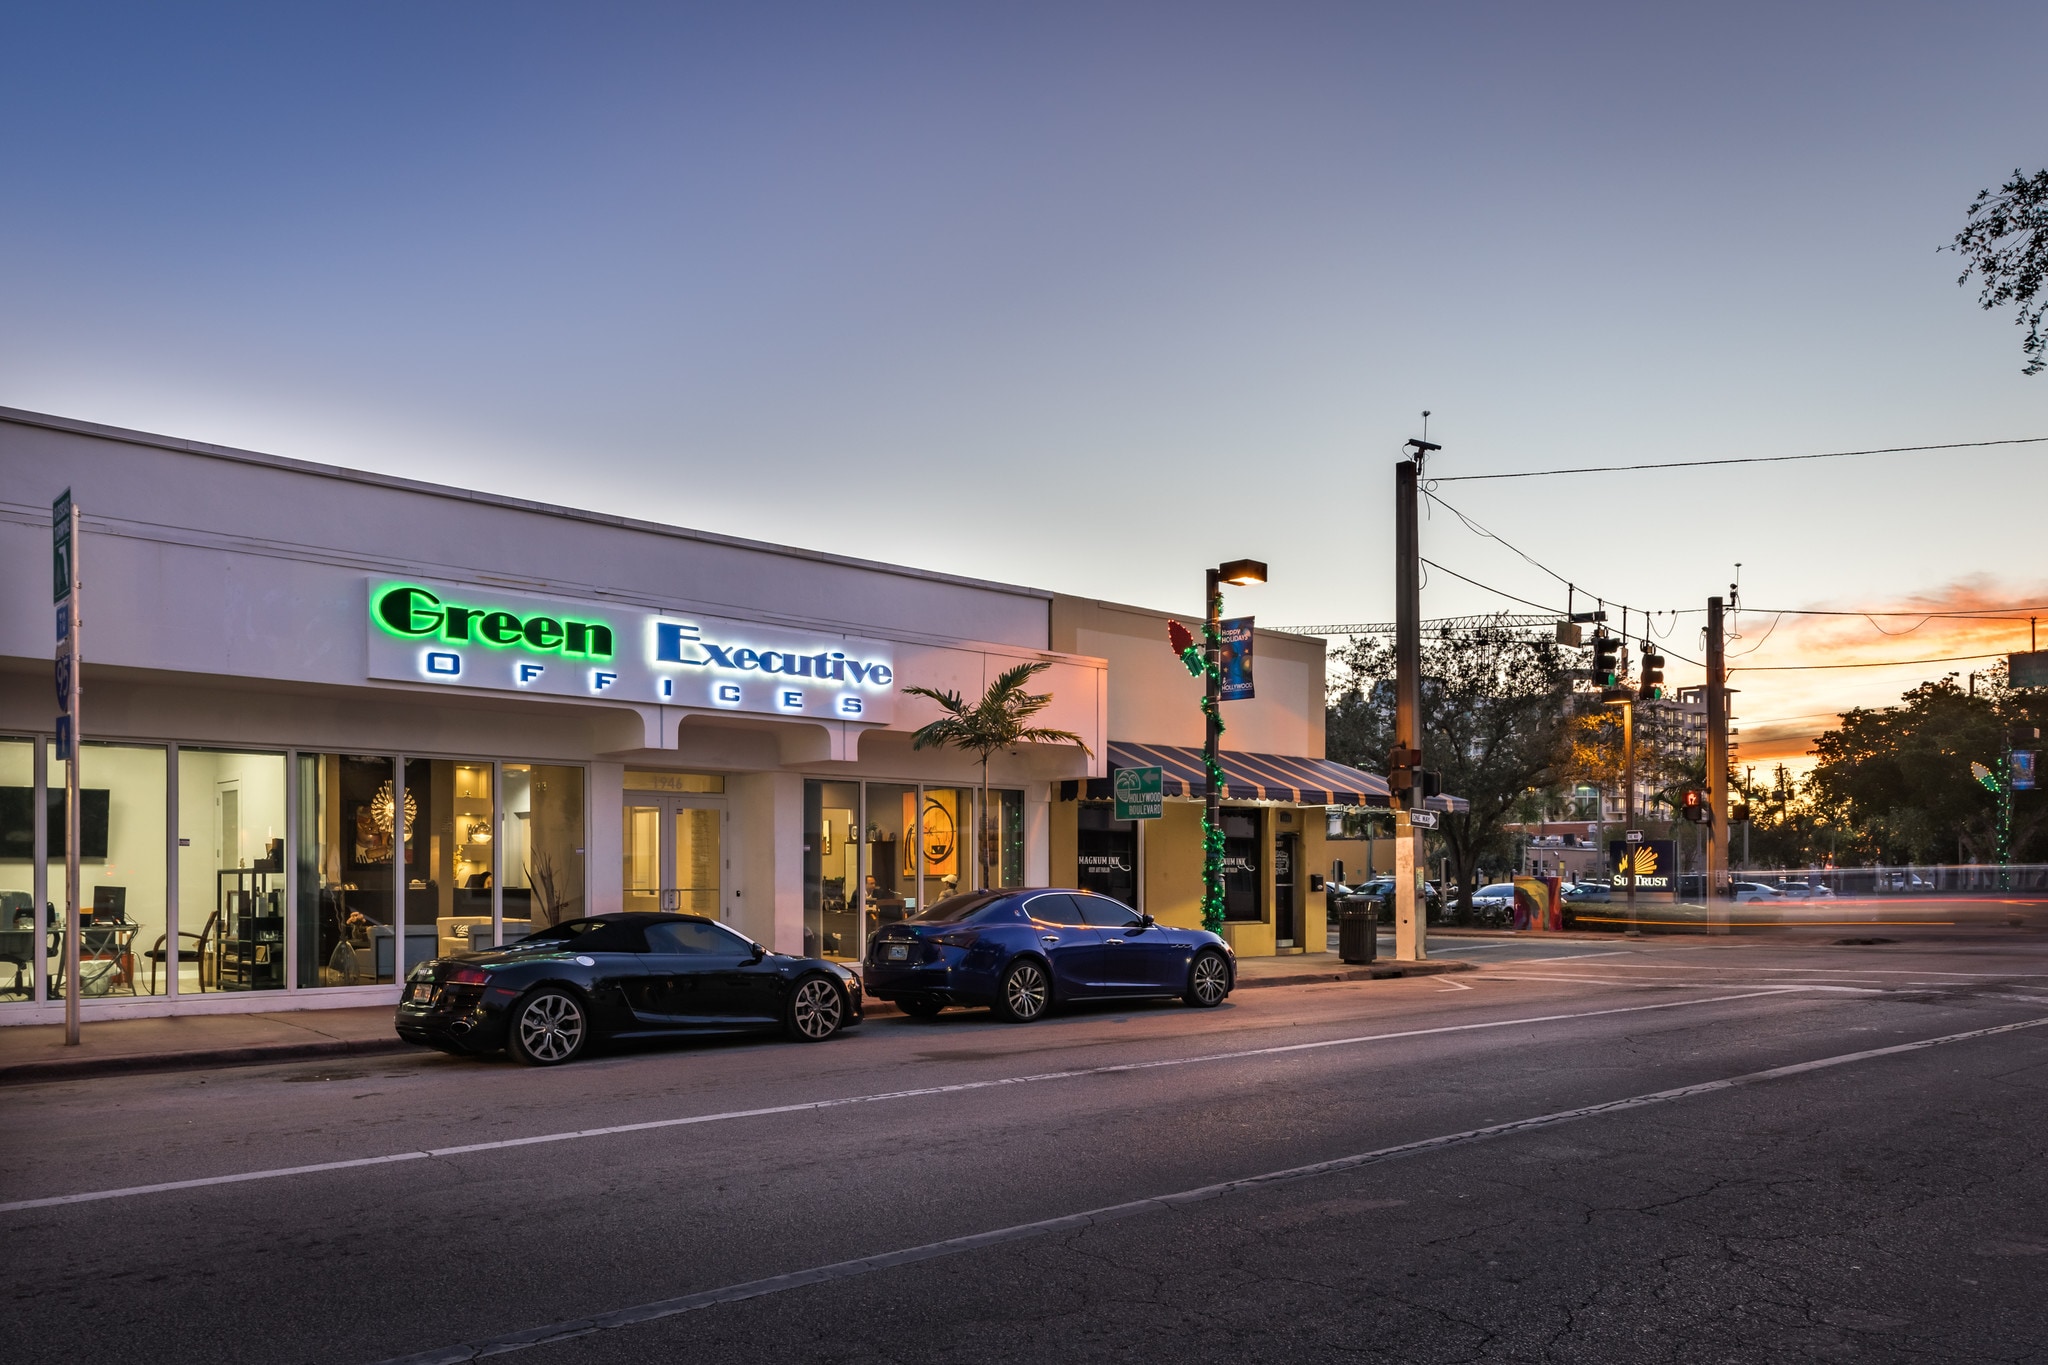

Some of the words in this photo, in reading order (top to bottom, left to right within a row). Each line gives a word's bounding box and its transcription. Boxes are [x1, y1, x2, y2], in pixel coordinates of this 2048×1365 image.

[379, 588, 614, 657] Green
[656, 621, 894, 686] Executive
[1221, 634, 1249, 644] HOLIDAYS
[57, 658, 69, 697] 95
[426, 652, 863, 713] OFFICES
[1222, 682, 1253, 691] HOLLYWOOD
[654, 775, 682, 789] 1946
[1129, 792, 1161, 803] HOLLYWOOD
[1129, 804, 1161, 815] BOULEVARD
[1413, 813, 1421, 821] ONE
[1422, 815, 1431, 823] WAY
[1078, 856, 1107, 864] MAGNUM
[1613, 875, 1668, 886] SUTRUST
